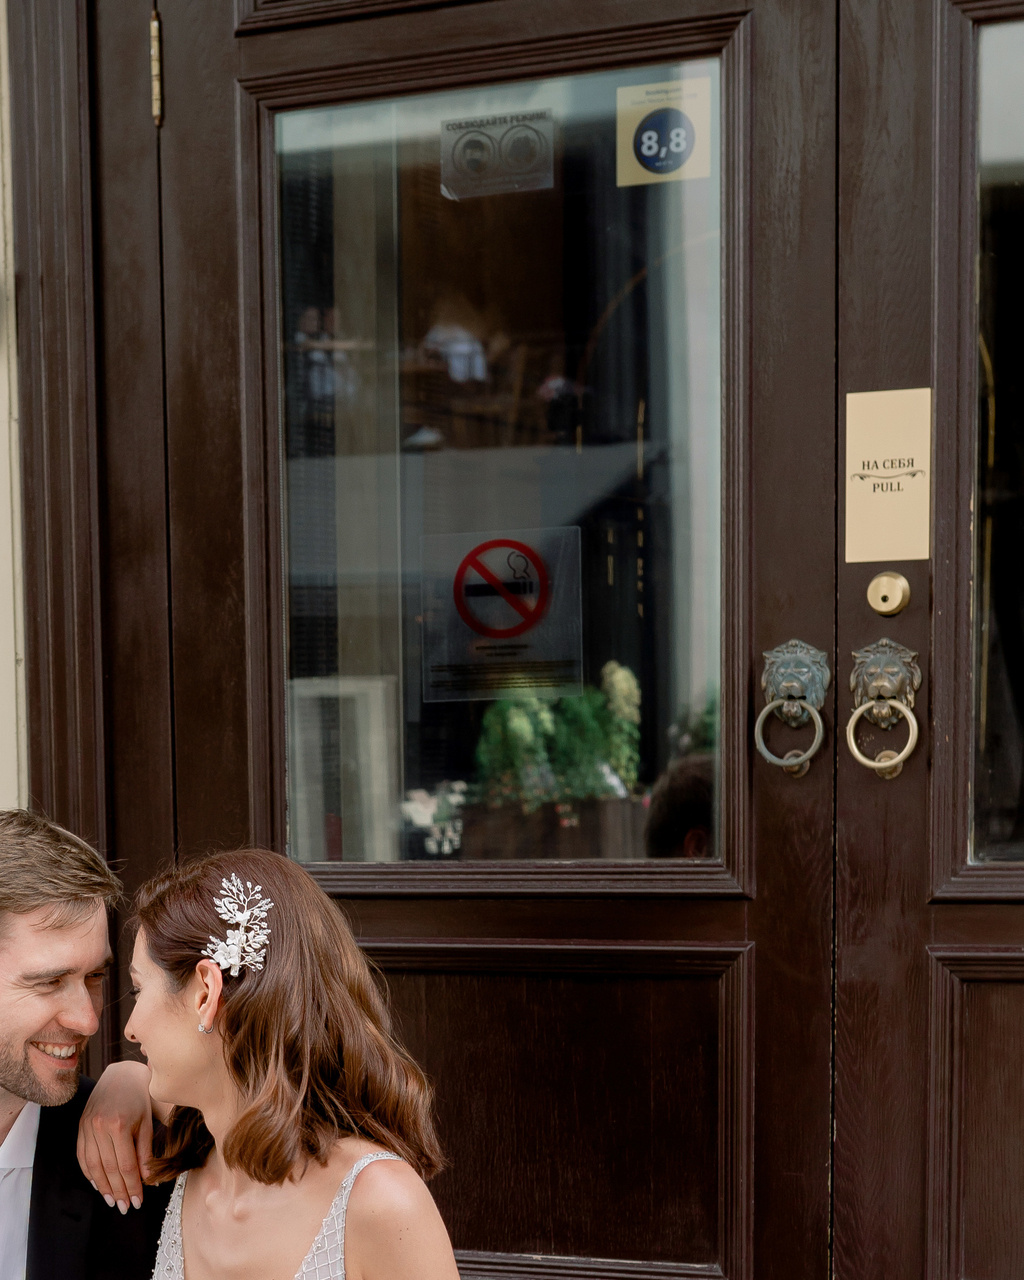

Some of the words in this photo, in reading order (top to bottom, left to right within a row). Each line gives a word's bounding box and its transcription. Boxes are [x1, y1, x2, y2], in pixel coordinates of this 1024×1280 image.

[641, 127, 687, 158] 8,8
[862, 460, 879, 471] НА
[882, 457, 914, 470] СЕБЯ
[872, 481, 904, 493] PULL
